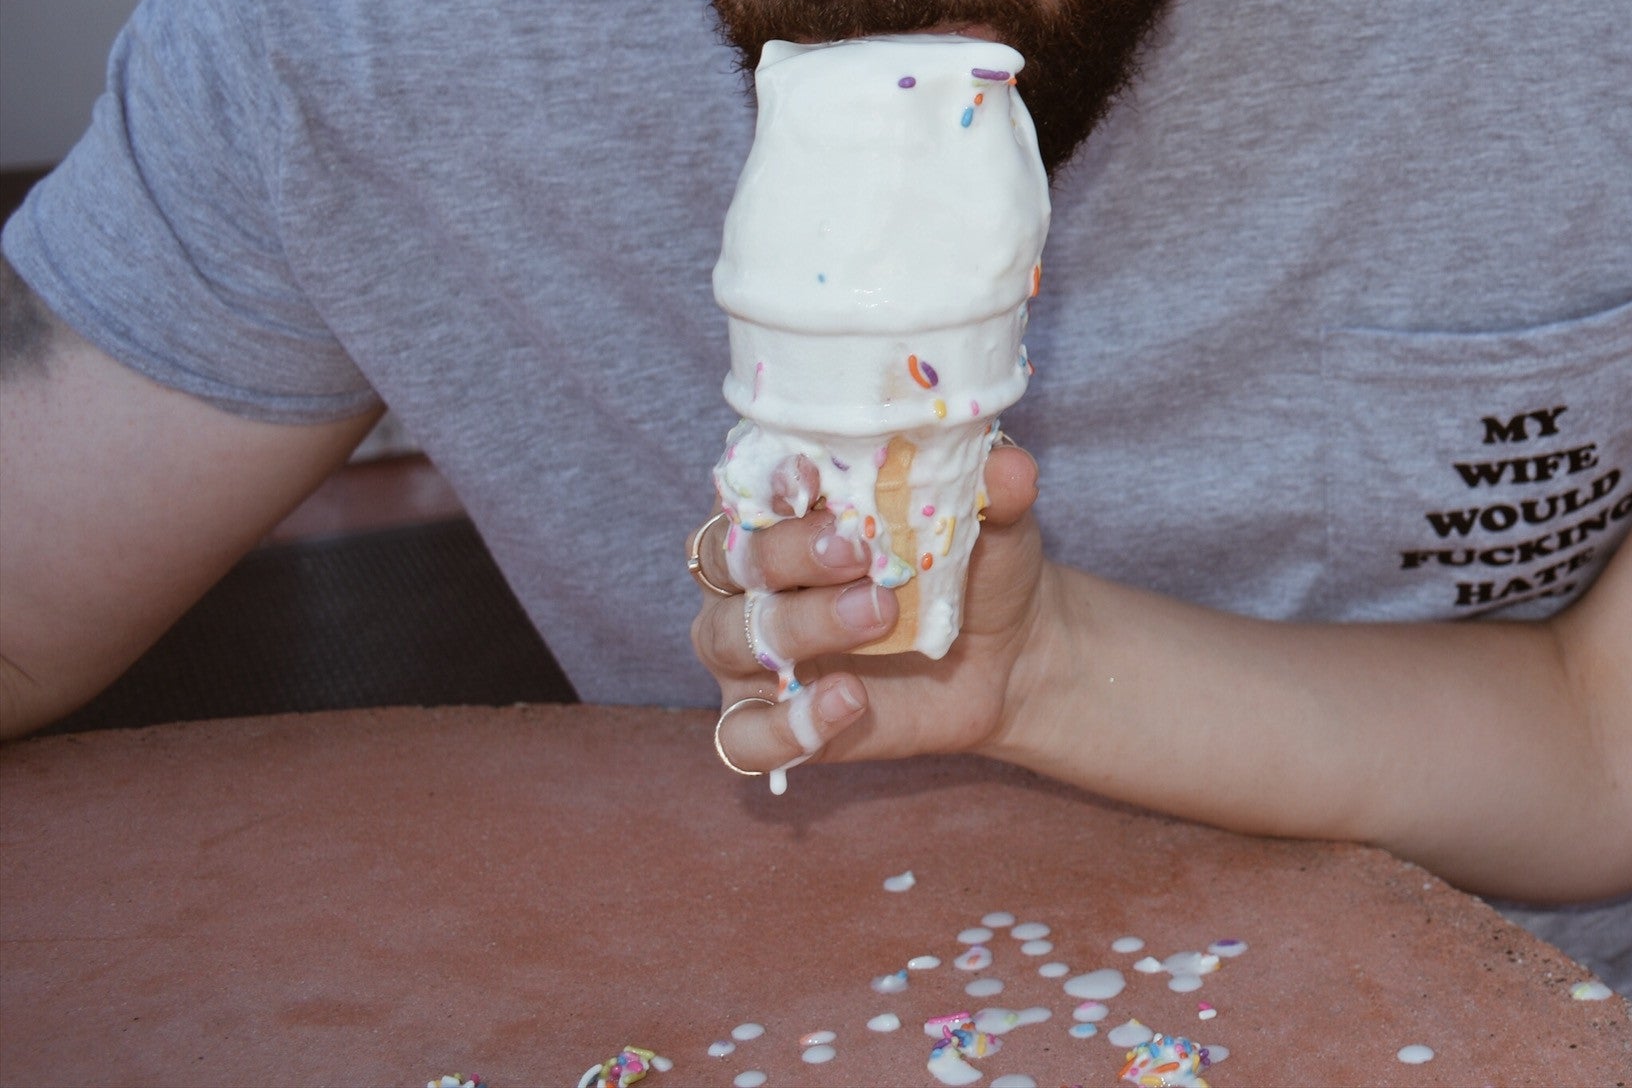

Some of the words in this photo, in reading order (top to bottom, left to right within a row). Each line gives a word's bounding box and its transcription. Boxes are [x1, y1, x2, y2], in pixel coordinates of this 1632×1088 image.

[1480, 406, 1568, 444] MY
[1454, 443, 1598, 488] WIFE
[1426, 469, 1621, 538] WOULD
[1454, 547, 1595, 606] HATE
